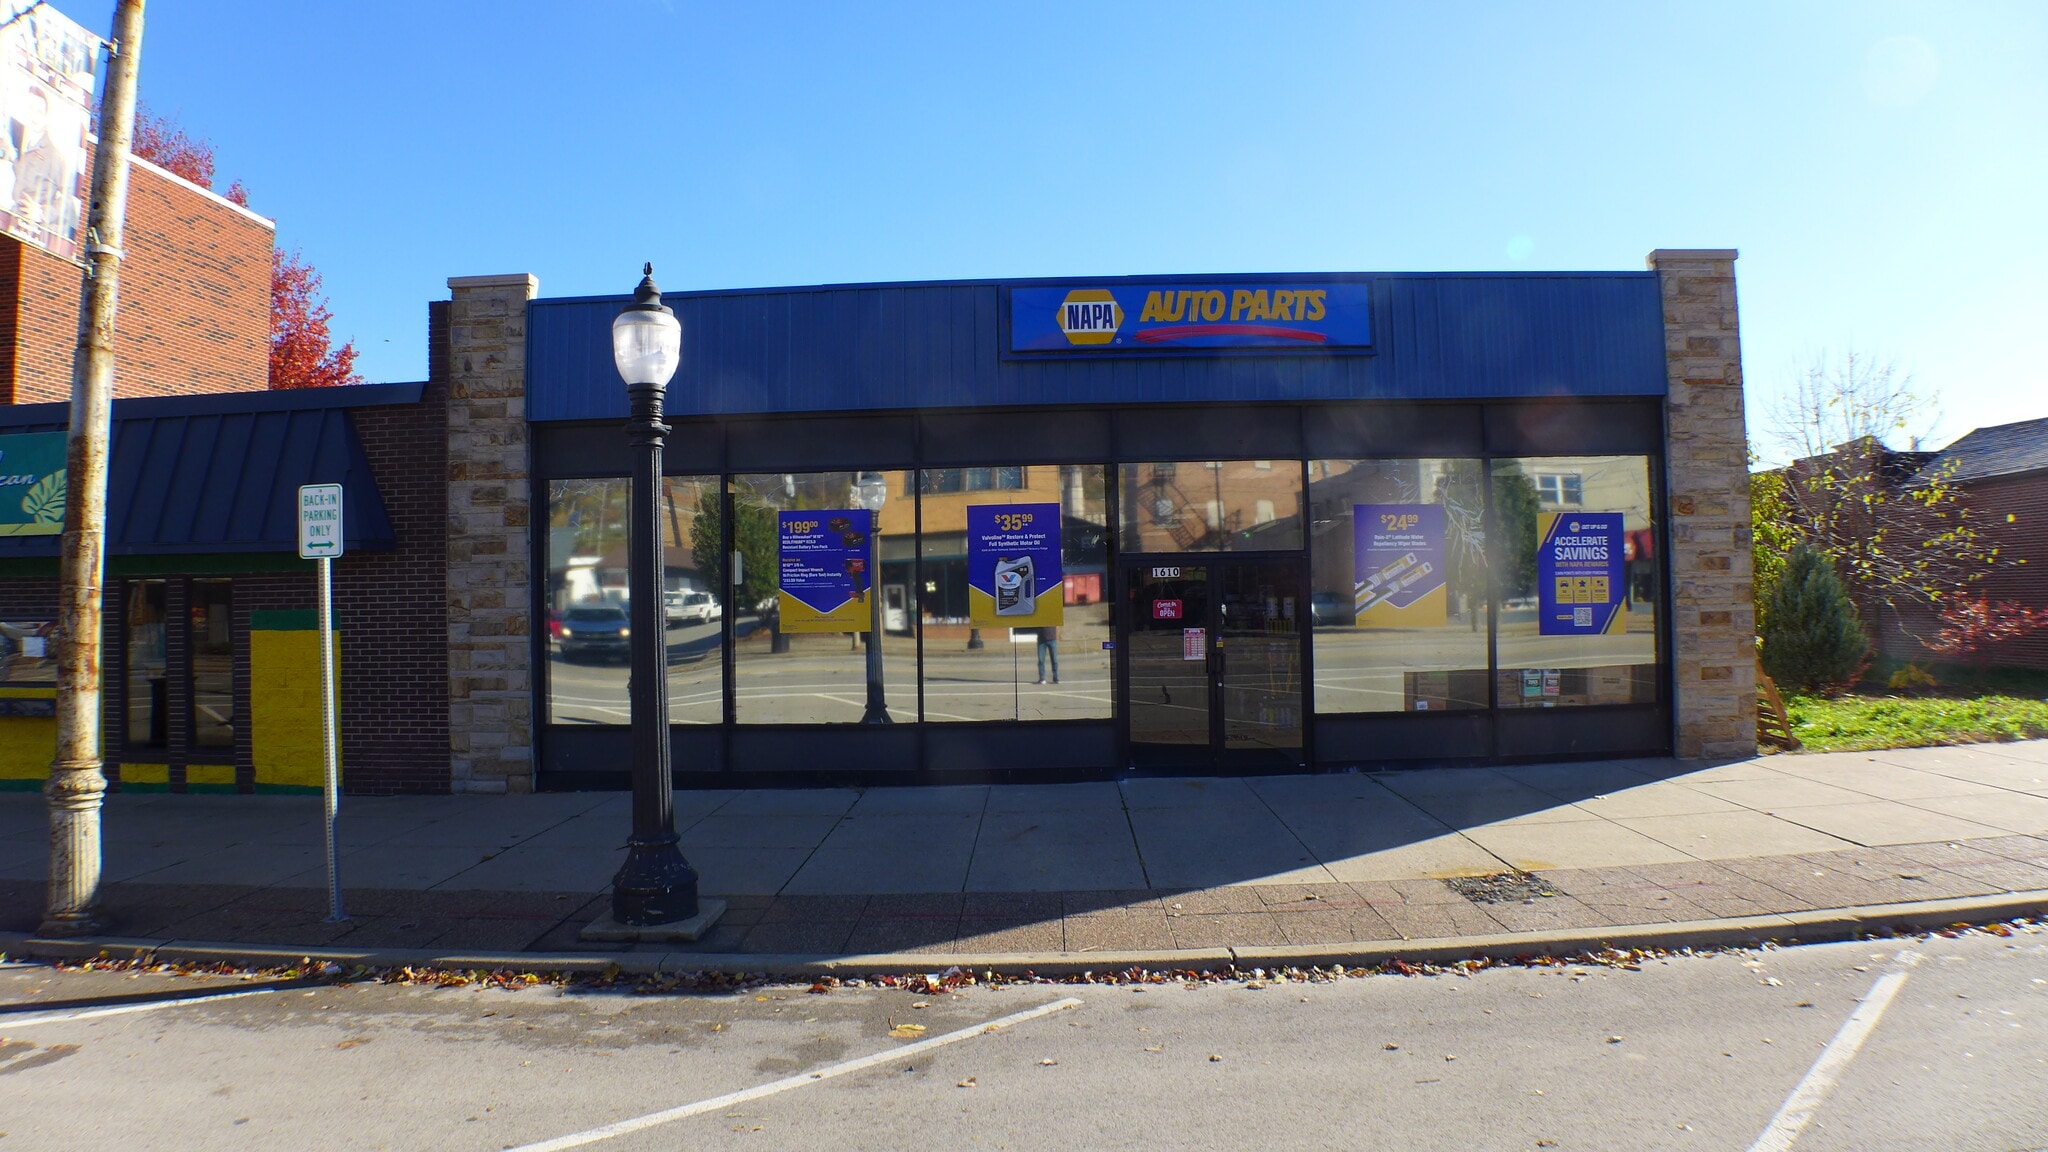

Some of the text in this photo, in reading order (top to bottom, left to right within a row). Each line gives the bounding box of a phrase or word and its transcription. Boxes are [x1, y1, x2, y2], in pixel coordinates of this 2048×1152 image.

[1067, 289, 1327, 330] NAPA AUTO PARTS
[303, 494, 337, 506] BACK-IN
[303, 509, 337, 522] PARKING
[310, 525, 331, 537] ONLY
[1554, 536, 1608, 546] ACCELERATE
[1554, 546, 1608, 560] SAVINGS
[1154, 568, 1179, 577] 1610
[1160, 609, 1175, 617] OPEN
